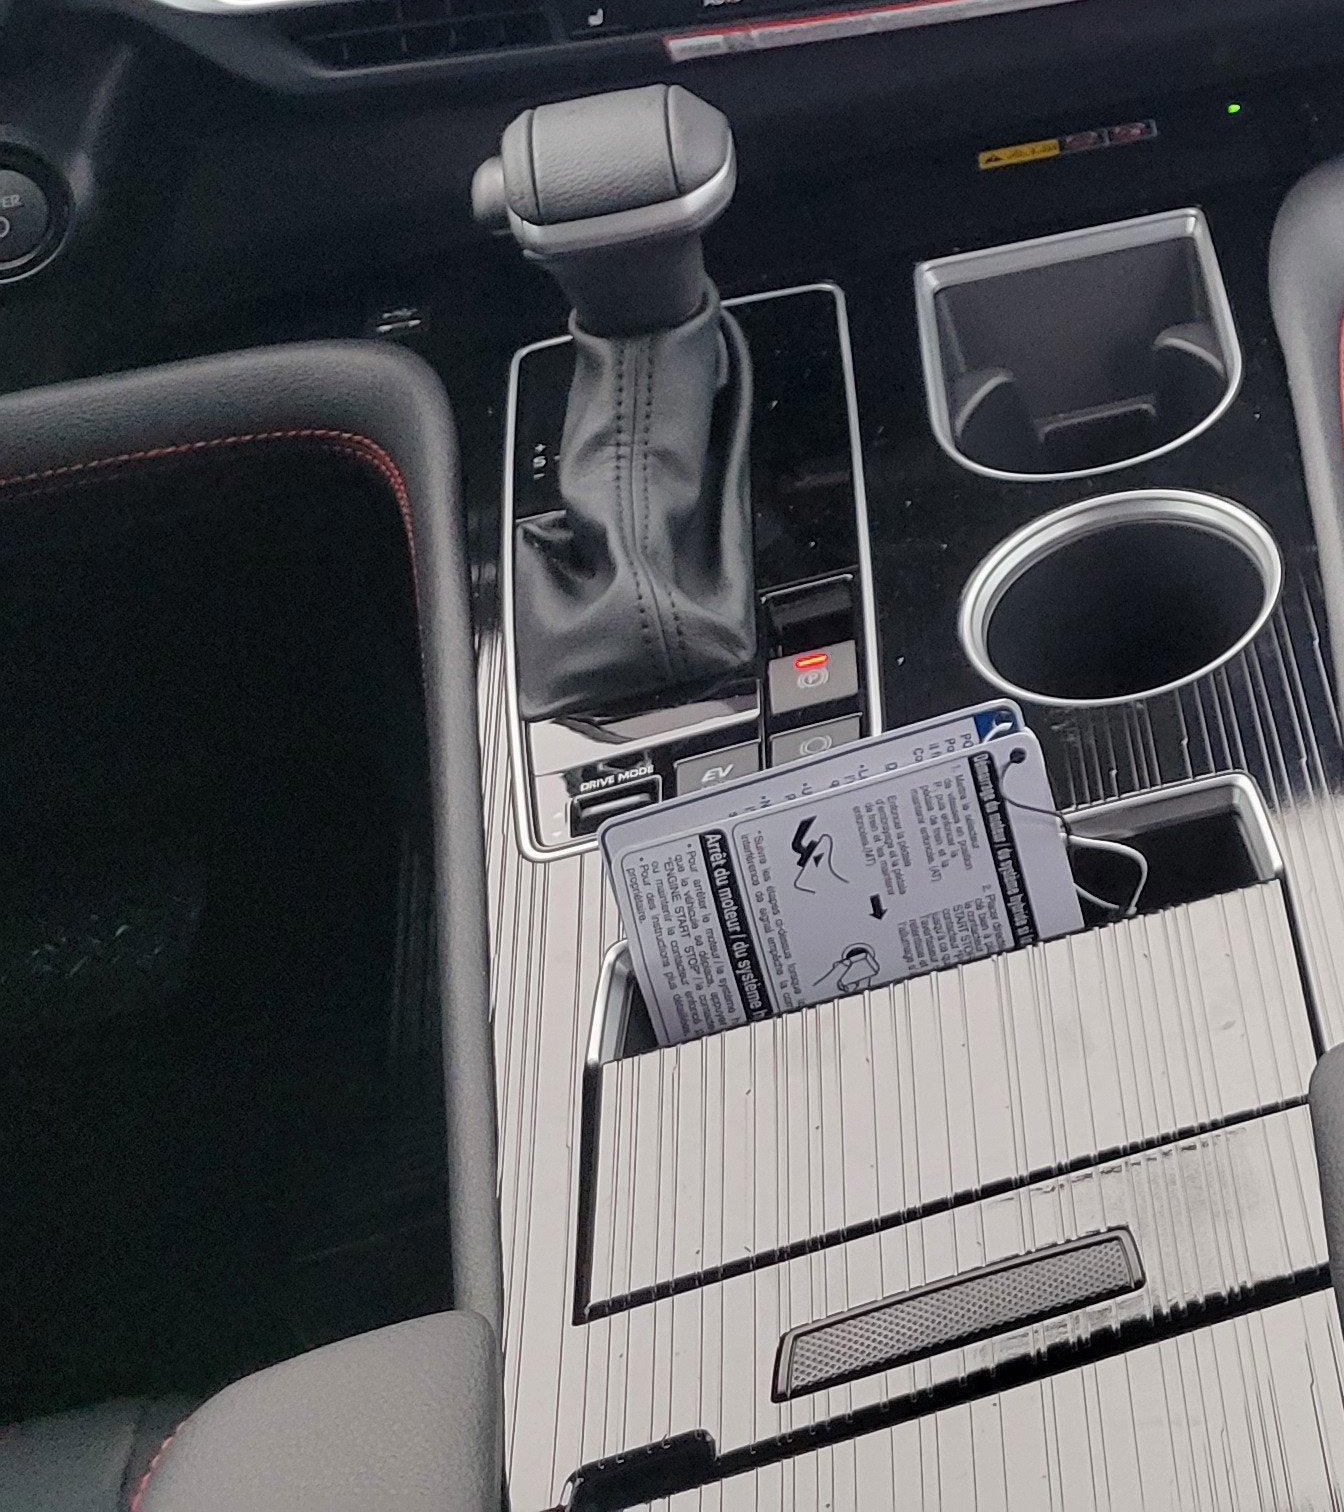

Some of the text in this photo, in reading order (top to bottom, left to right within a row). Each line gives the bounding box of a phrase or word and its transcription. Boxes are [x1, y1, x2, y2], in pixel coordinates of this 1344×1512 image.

[580, 764, 655, 792] DRIVE MODE
[702, 764, 734, 783] EV
[704, 834, 726, 868] Arrêt
[638, 863, 651, 886] Pour
[685, 850, 699, 872] Pour
[692, 878, 707, 909] arrêter
[713, 867, 730, 886] du
[645, 892, 656, 910] des
[673, 854, 685, 873] que
[683, 889, 699, 929] véhicule
[650, 860, 660, 873] ou
[655, 878, 673, 922] maintenir
[669, 939, 690, 986] contacteur
[674, 905, 691, 937] START
[717, 886, 740, 932] moteur
[952, 904, 969, 932] START
[650, 913, 671, 967] instructions
[731, 940, 749, 958] du
[734, 959, 762, 1009] système
